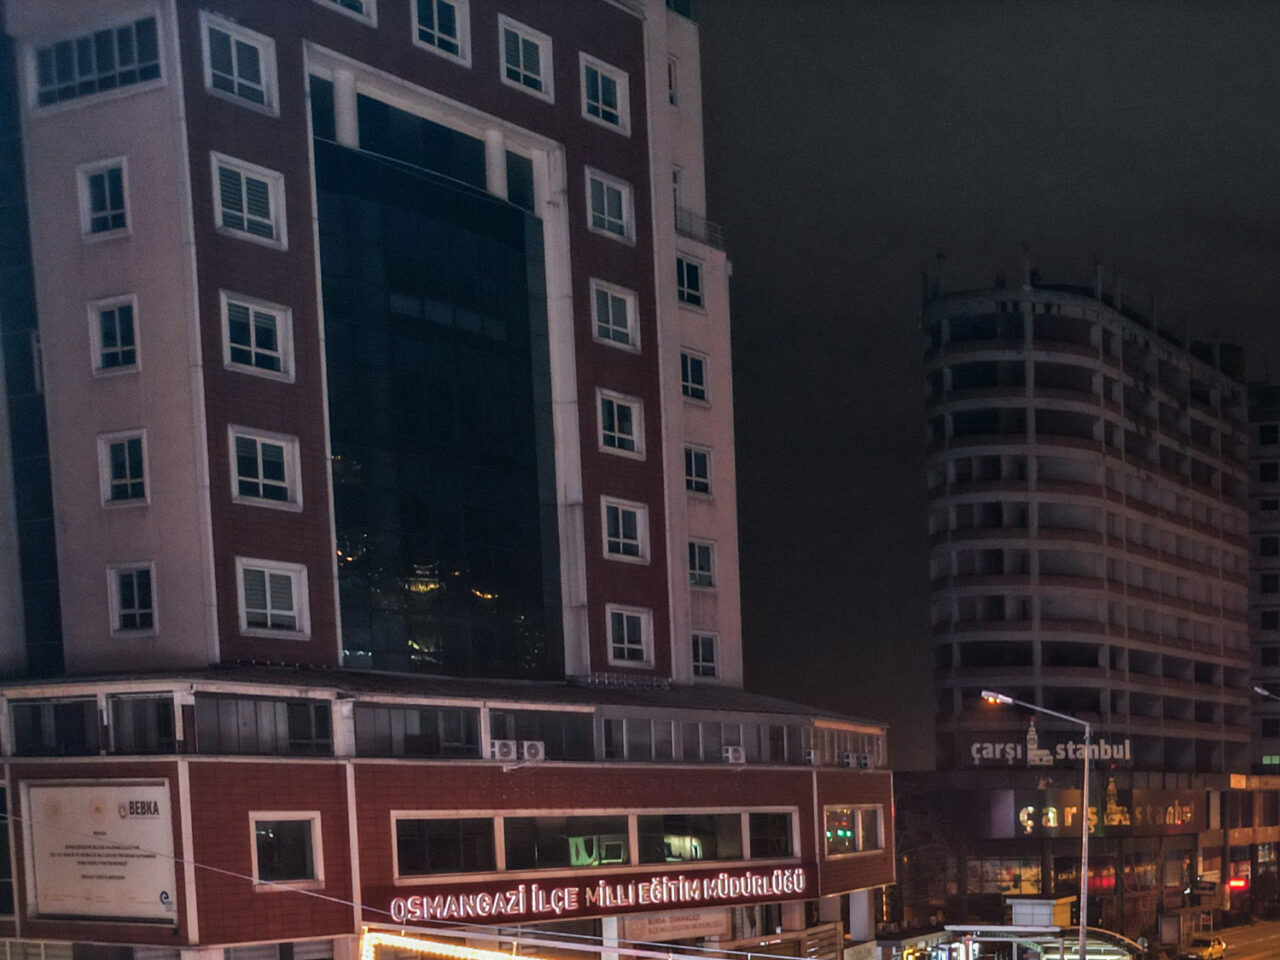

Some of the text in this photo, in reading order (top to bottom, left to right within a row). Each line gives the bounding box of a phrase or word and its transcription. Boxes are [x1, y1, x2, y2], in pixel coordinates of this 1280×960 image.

[971, 741, 1022, 765] çarşı
[129, 801, 159, 815] BEBKA
[390, 868, 806, 922] OSMANGAZİ İLÇE MİLLİ EĞİTİM MÜDÜRLÜĞÜ
